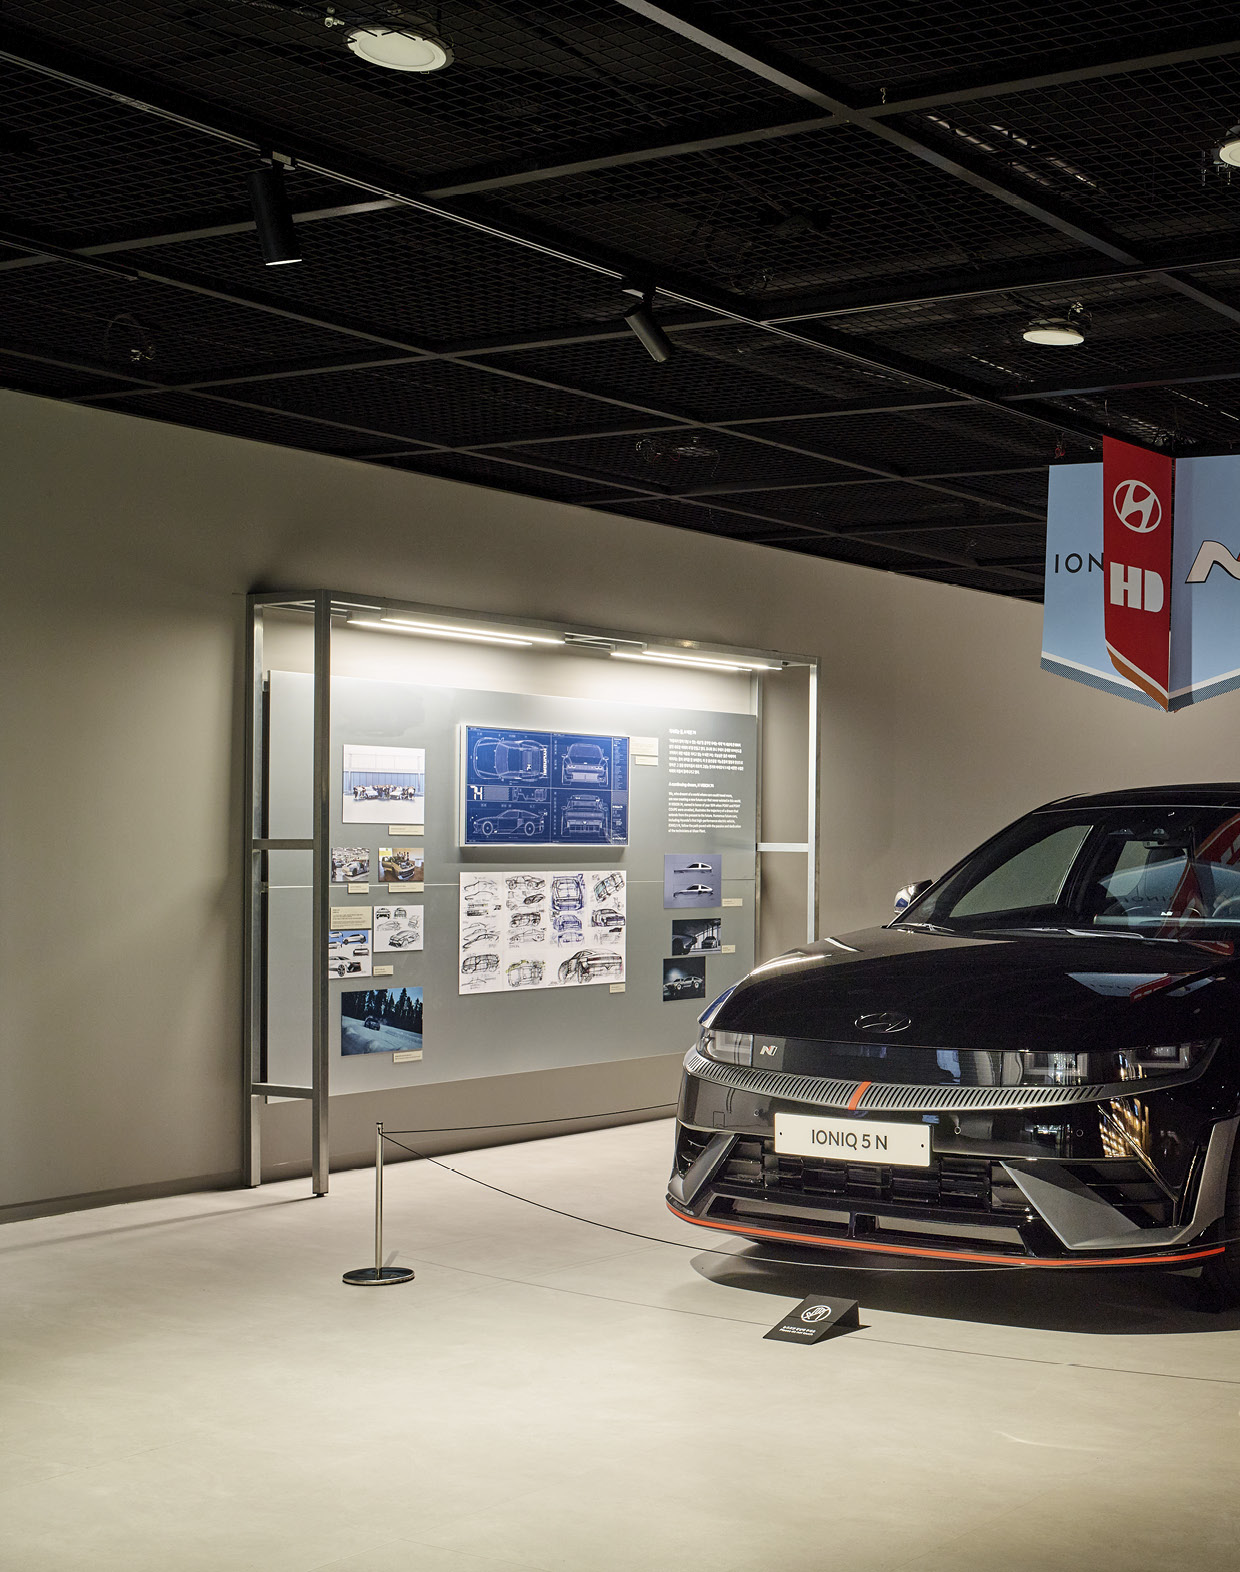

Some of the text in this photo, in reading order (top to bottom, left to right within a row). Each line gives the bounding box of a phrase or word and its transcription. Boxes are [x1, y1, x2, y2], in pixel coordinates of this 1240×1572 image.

[1110, 561, 1164, 613] HD
[812, 1129, 887, 1150] IONIQ 5 N
